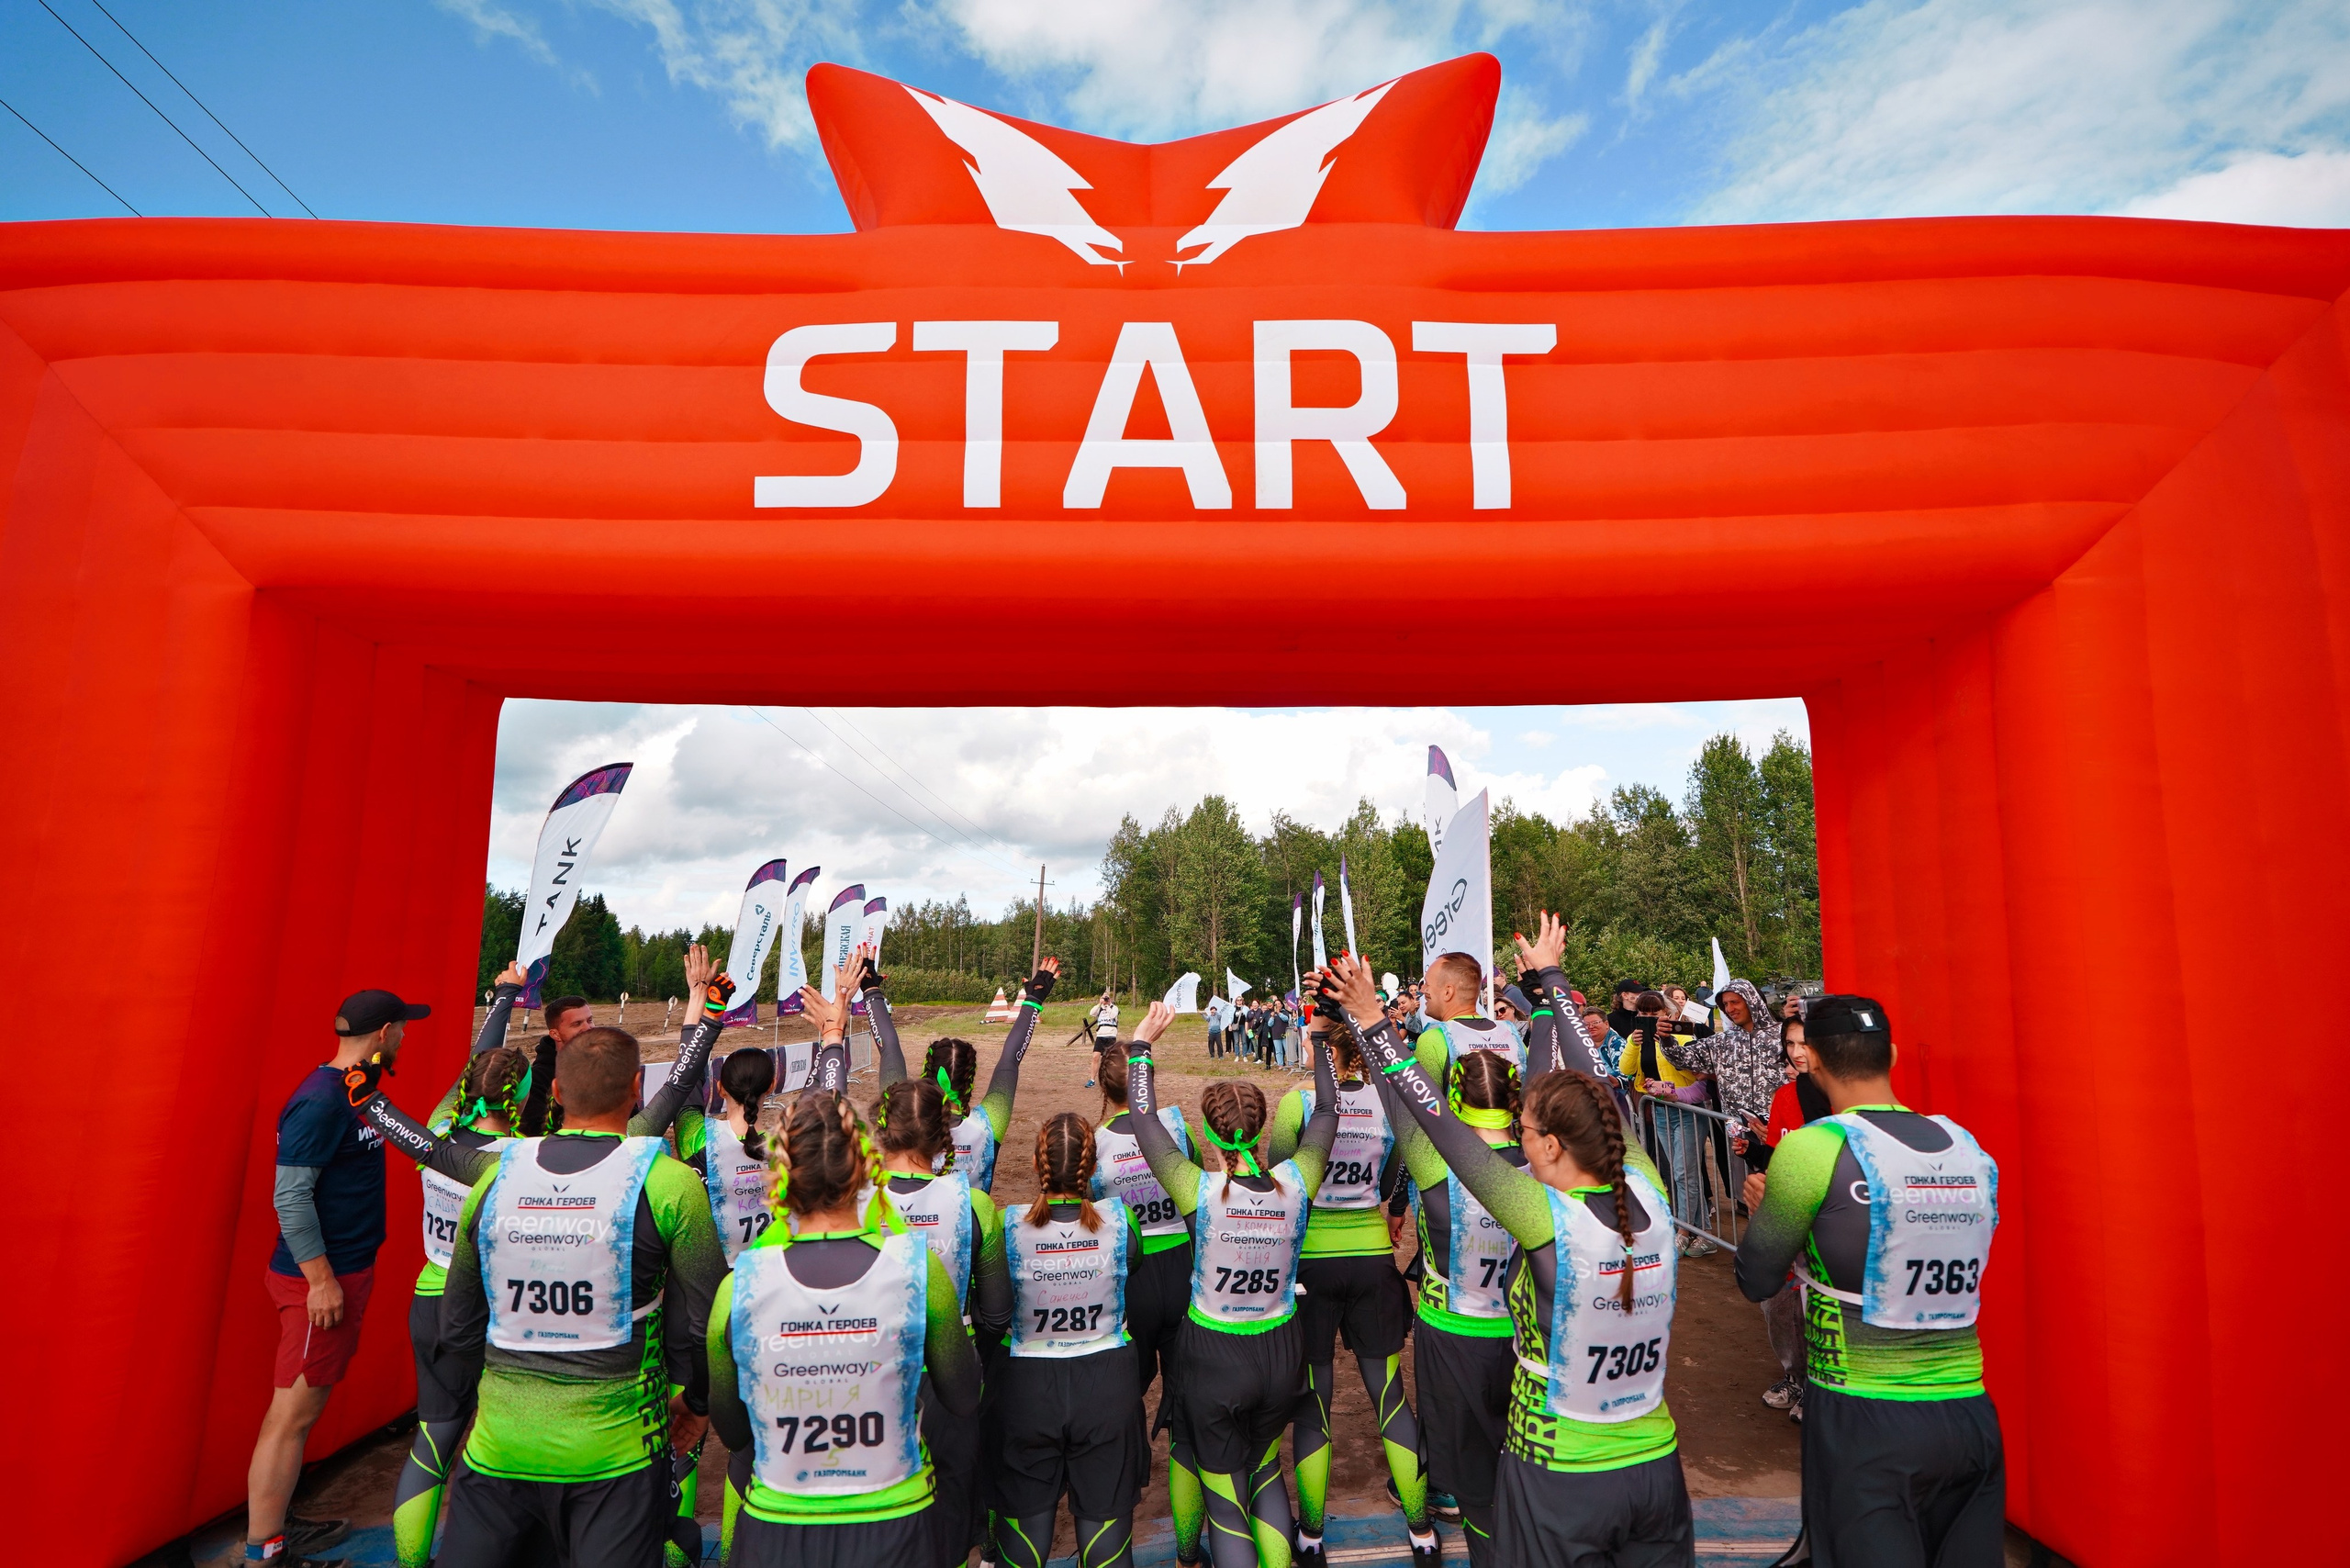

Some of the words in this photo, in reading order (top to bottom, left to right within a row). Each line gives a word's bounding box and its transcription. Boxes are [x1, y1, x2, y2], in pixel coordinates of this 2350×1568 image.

[754, 319, 1558, 510] START
[535, 836, 582, 936] TANK
[746, 911, 771, 981] Северсталь
[838, 925, 852, 970] НЕЖСКАЯ
[1556, 998, 1608, 1078] Greenway
[668, 1022, 707, 1084] Greenway
[1372, 1030, 1437, 1104] Greeway
[370, 1100, 428, 1149] Greenway
[1113, 1150, 1136, 1161] ГОНКА
[736, 1164, 762, 1172] ГОНКА
[1113, 1171, 1156, 1186] Greenw
[1322, 1161, 1373, 1185] 7284
[1904, 1176, 1936, 1185] ГОНКА
[1941, 1176, 1976, 1185] ГЕРОЕВ
[518, 1196, 553, 1206] ГОНКА
[556, 1196, 596, 1206] ГЕРОЕВ
[1133, 1198, 1177, 1226] 289
[1225, 1207, 1253, 1216] ГОНКА
[1255, 1209, 1286, 1218] ГЕРОЕВ
[426, 1210, 458, 1244] 727
[739, 1212, 772, 1244] 72
[904, 1214, 939, 1223] ГЕРОЕВ
[1905, 1209, 1975, 1226] Greenway
[508, 1230, 585, 1248] Greenway
[1035, 1243, 1064, 1251] ГОНКА
[1066, 1239, 1099, 1249] ГЕРОЕВ
[1220, 1232, 1280, 1248] Greenway
[1234, 1250, 1270, 1265] ЖЕНЯ
[1599, 1260, 1627, 1271] ГОНКА
[1634, 1253, 1661, 1267] ЕРОЕВ
[1033, 1269, 1094, 1282] Greenway
[1214, 1266, 1280, 1294] 7285
[1480, 1258, 1507, 1289] 72
[1906, 1258, 1979, 1295] 7363
[508, 1279, 594, 1316] 7306
[1037, 1290, 1089, 1306] Санечка
[781, 1321, 823, 1332] ГОНКА
[828, 1317, 877, 1330] ГЕРОЕВ
[1034, 1303, 1103, 1333] 7287
[774, 1361, 869, 1377] Greenway
[1586, 1337, 1662, 1384] 7305
[777, 1411, 884, 1454] 7290
[813, 1469, 867, 1478] ГАЗПРОМБАНК
